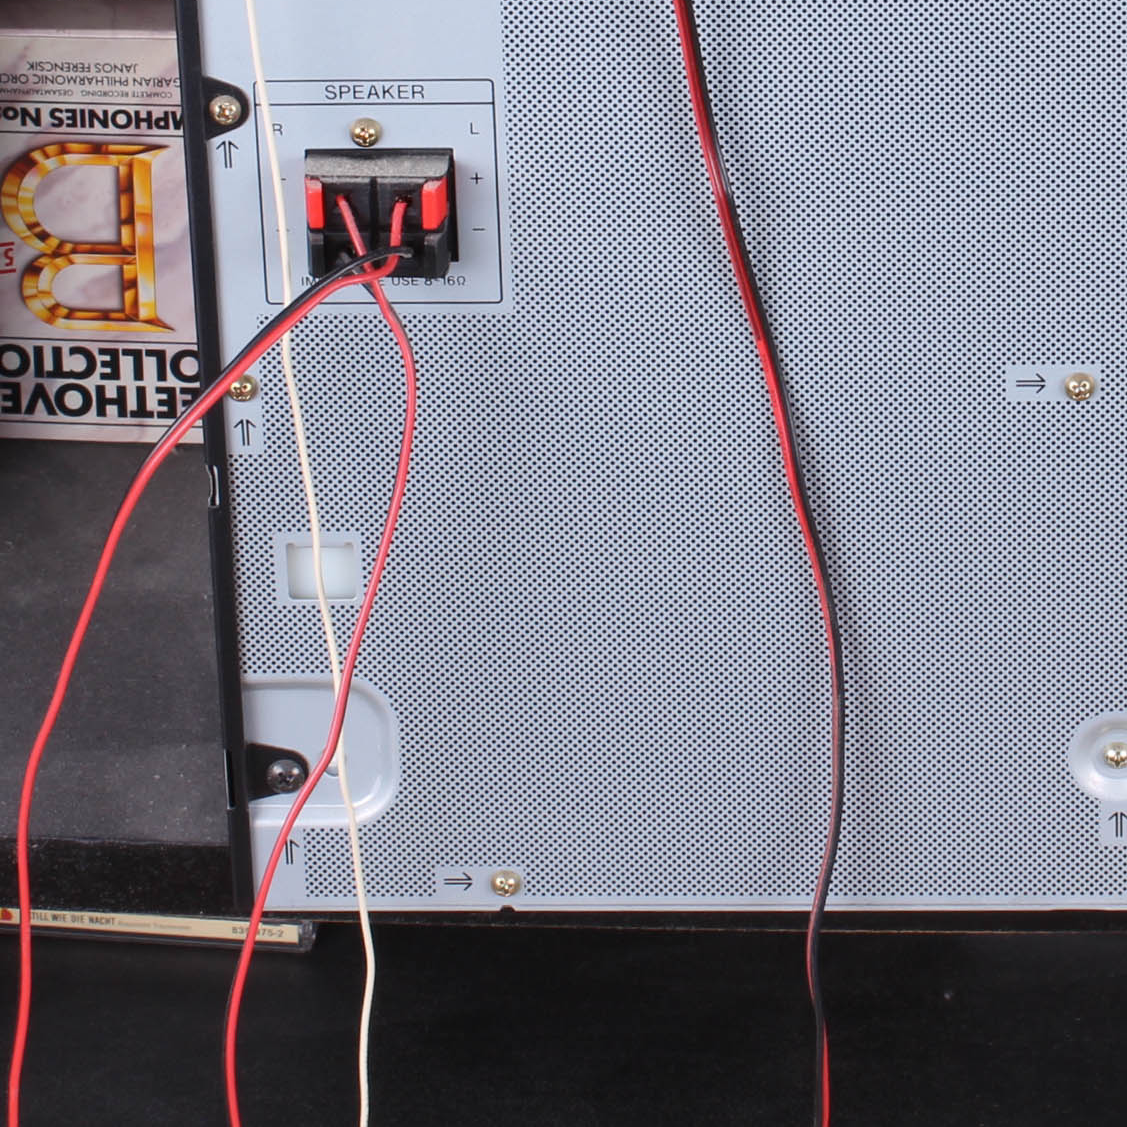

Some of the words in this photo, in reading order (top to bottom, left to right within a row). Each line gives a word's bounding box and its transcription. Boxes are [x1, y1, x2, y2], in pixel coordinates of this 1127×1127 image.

[27, 62, 91, 73] FERENCSIK
[95, 63, 138, 73] JANOS
[33, 75, 128, 86] PHILHARMONIC
[132, 90, 172, 98] COMPLETE
[325, 85, 425, 100] SPEAKER
[470, 123, 479, 135] L
[392, 276, 419, 286] USE
